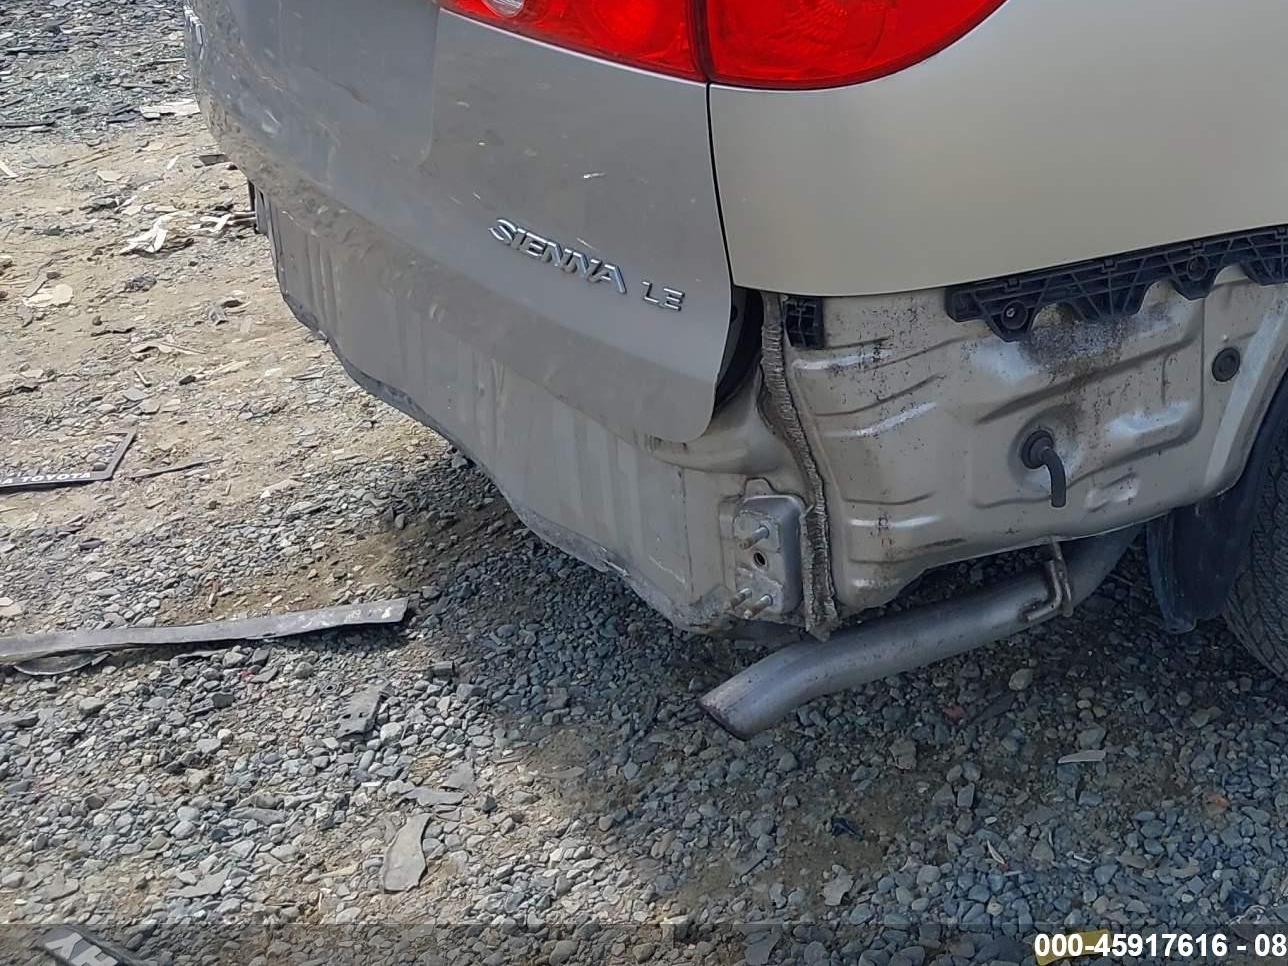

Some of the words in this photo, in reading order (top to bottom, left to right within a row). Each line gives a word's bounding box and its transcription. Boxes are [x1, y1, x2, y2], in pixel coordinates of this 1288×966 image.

[488, 217, 627, 295] SIENNA
[641, 280, 685, 312] LE
[21, 472, 91, 482] TOYOTA
